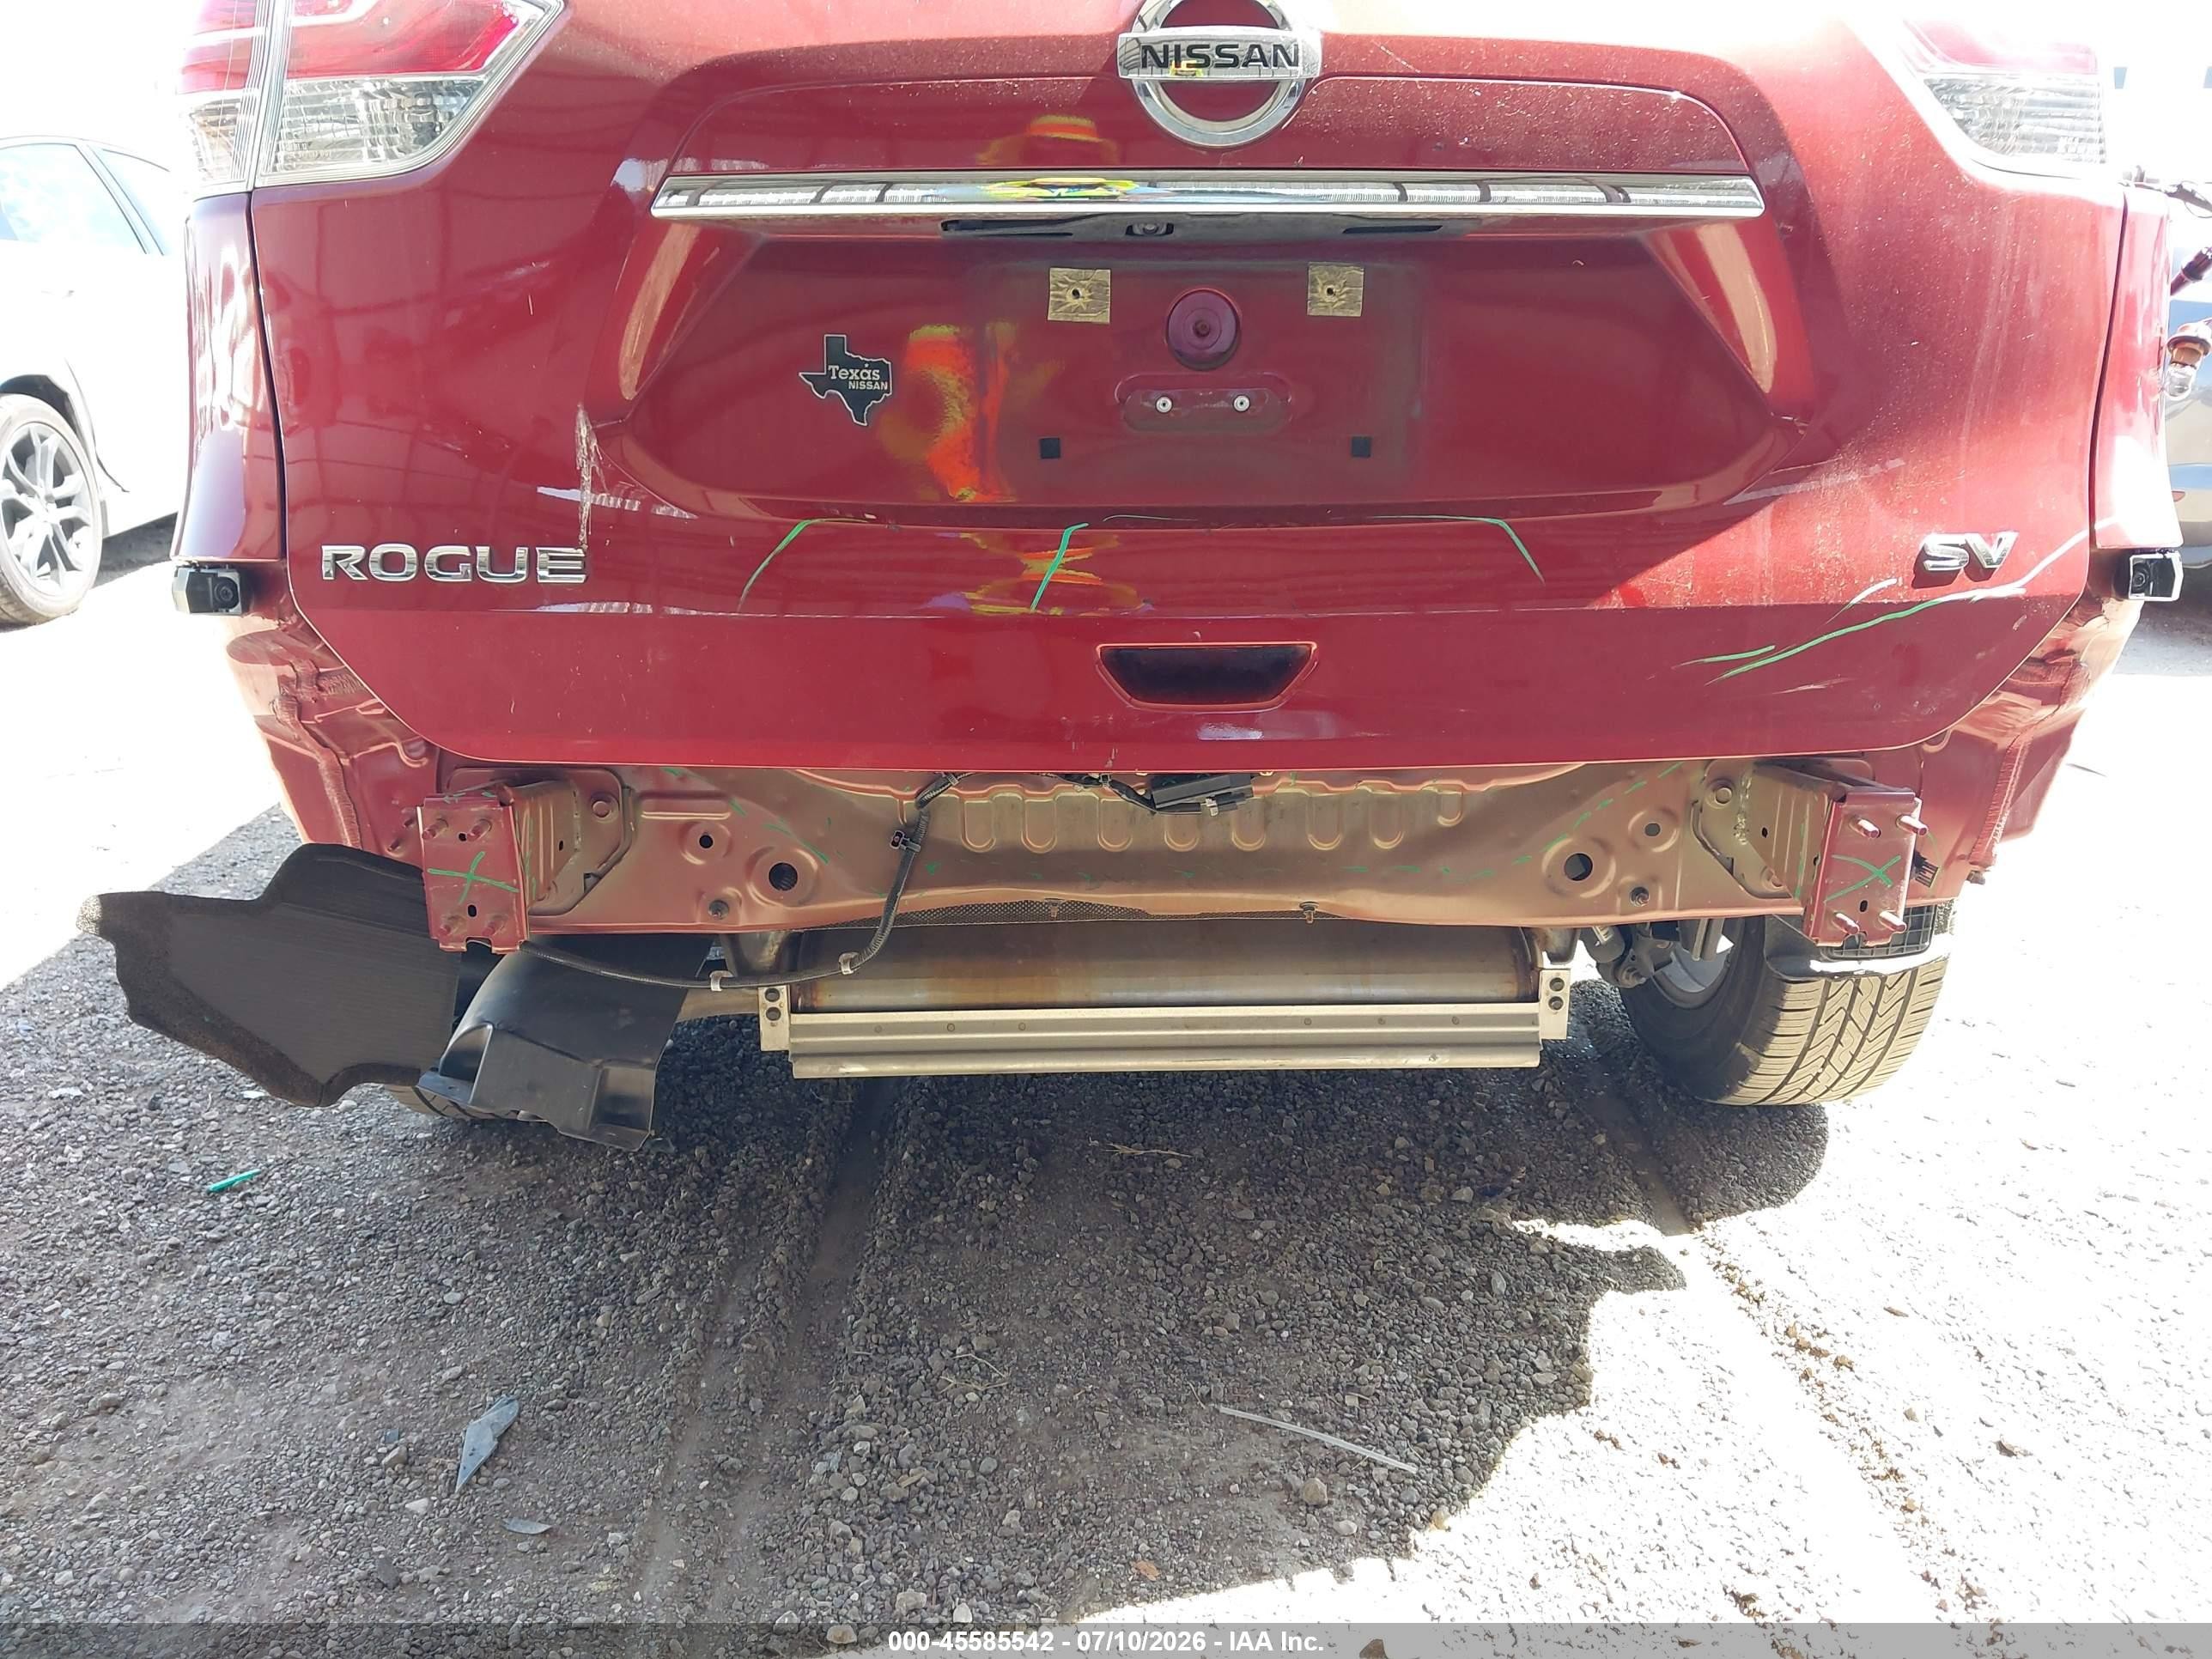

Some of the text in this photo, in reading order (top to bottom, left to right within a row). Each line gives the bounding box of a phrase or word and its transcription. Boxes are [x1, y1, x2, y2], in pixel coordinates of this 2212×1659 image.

[1141, 44, 1299, 70] NISSAN
[828, 365, 880, 380] Texas
[848, 381, 888, 391] NISSAN
[321, 543, 586, 583] ROGUE
[1921, 531, 2020, 572] SV
